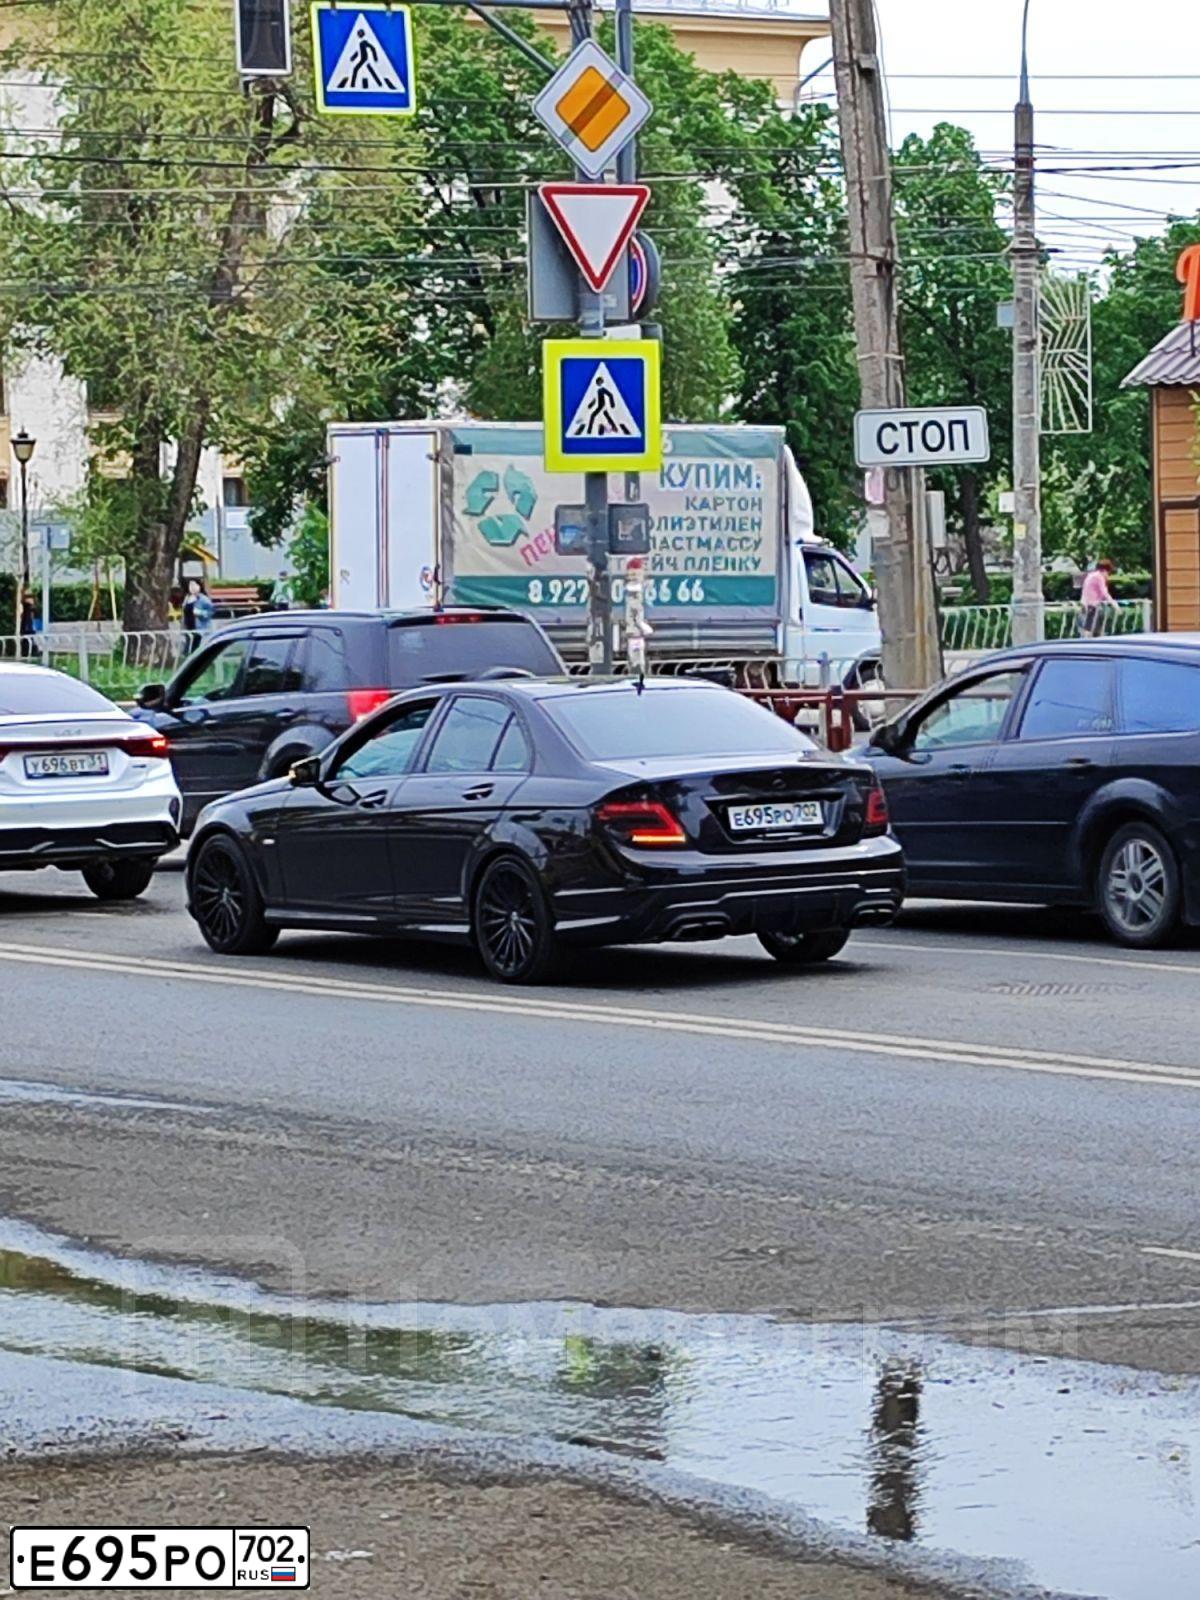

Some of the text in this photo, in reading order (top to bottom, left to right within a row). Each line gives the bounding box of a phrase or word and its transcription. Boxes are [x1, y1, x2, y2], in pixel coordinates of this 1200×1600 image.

[876, 420, 970, 455] СТОП
[685, 496, 762, 512] КАРТОН
[648, 515, 762, 531] ОЛИЭТИЛЕН
[684, 555, 762, 571] ПЛЕНКУ
[528, 579, 543, 604] 8
[677, 579, 705, 602] 66
